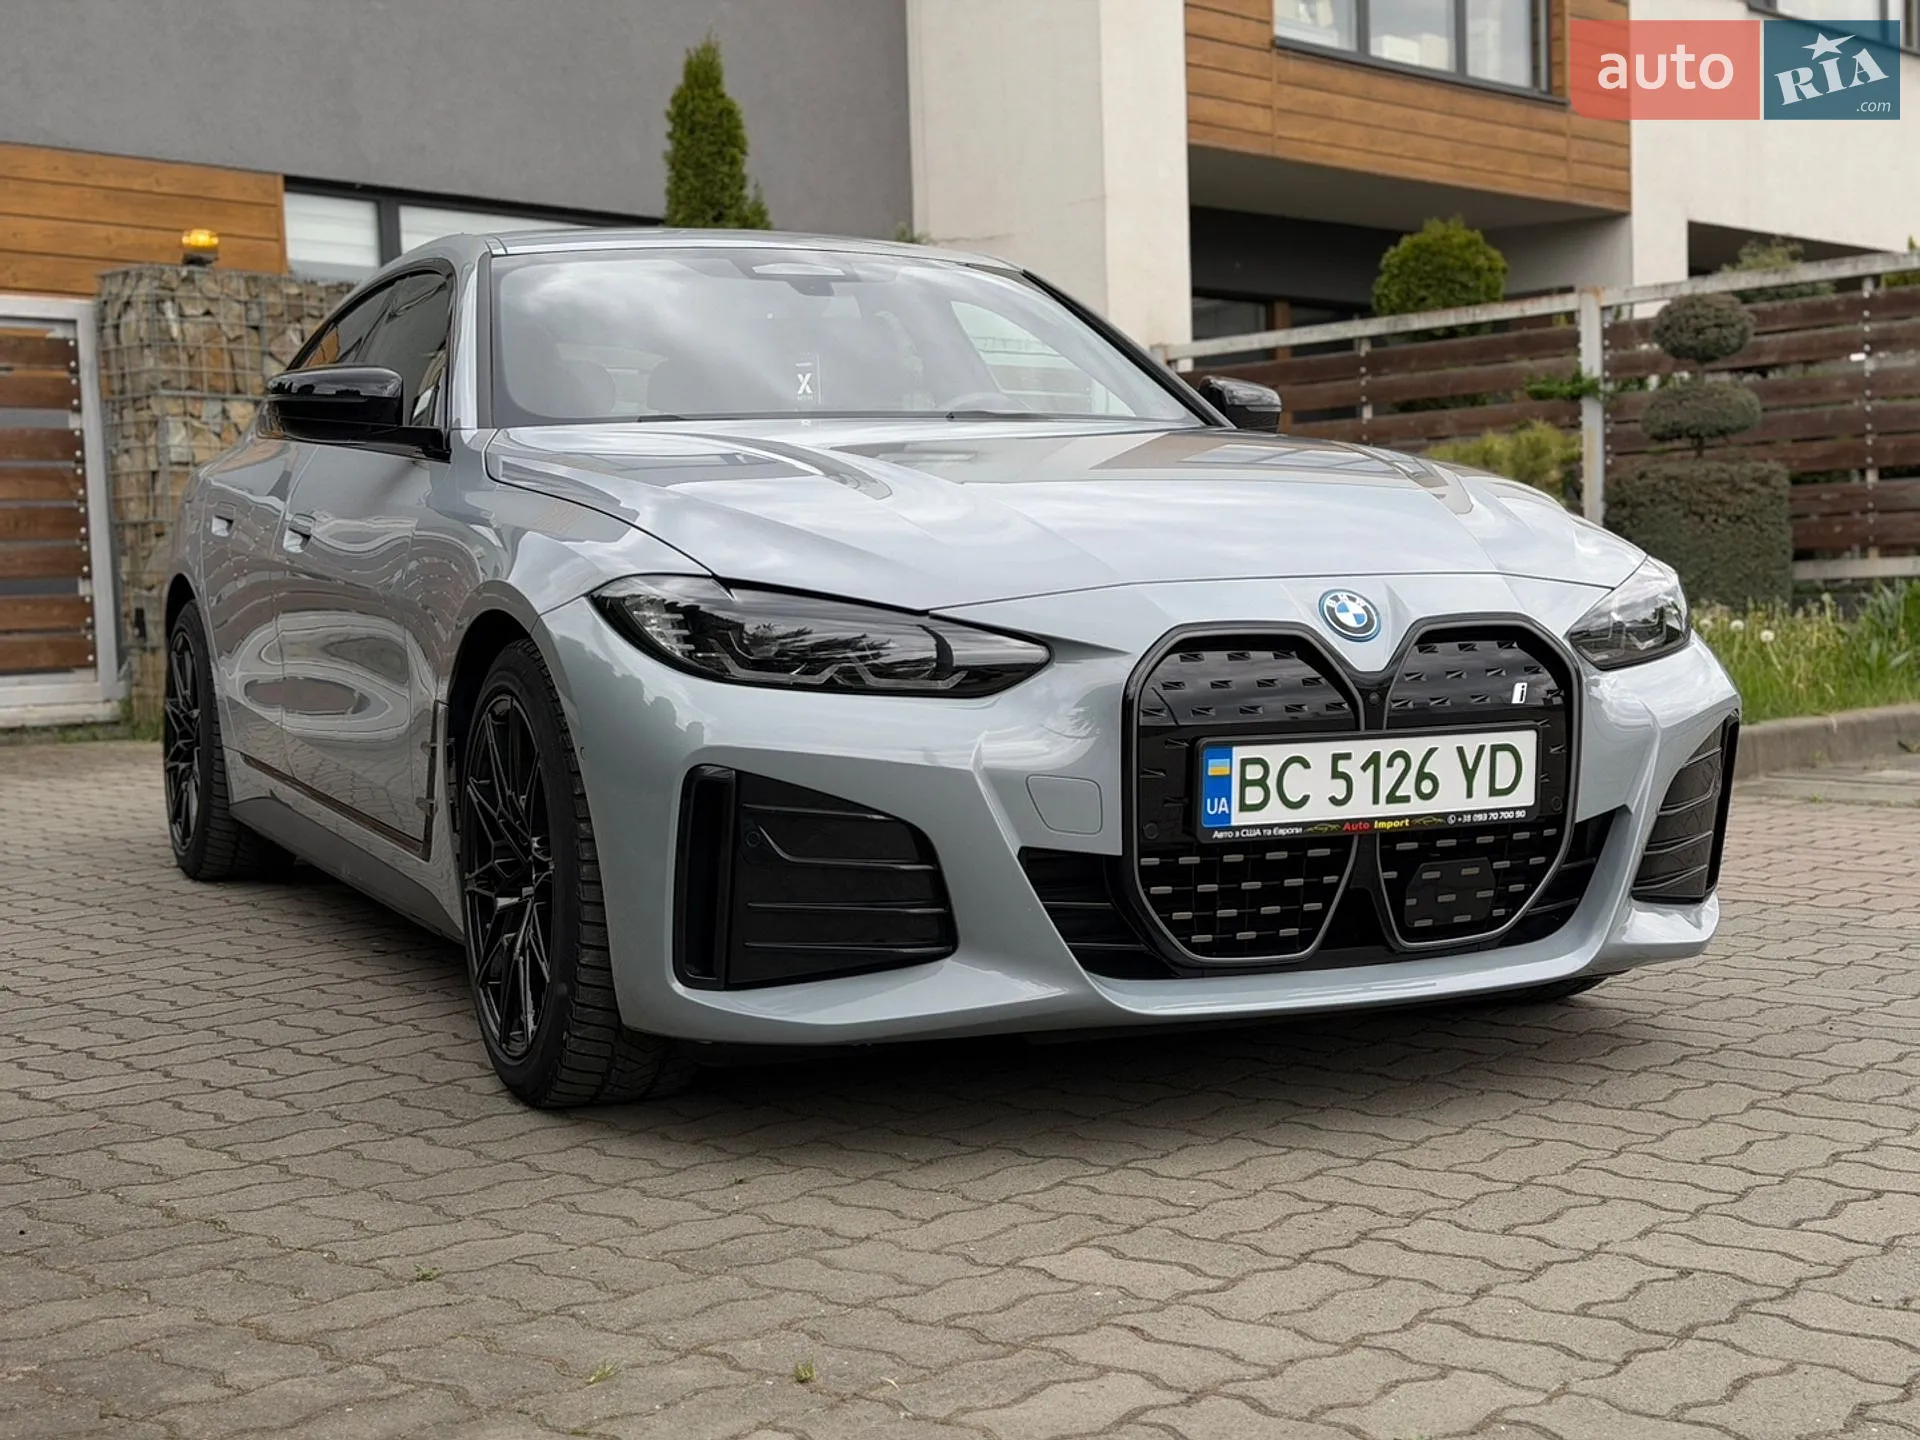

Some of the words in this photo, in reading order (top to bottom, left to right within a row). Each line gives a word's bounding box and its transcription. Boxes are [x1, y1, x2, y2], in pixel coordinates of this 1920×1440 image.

[1239, 755, 1312, 812] BC
[1327, 746, 1440, 807] 5126
[1456, 743, 1523, 799] YD
[1206, 797, 1230, 815] UA
[1343, 822, 1370, 831] Auto
[1374, 818, 1410, 830] Import
